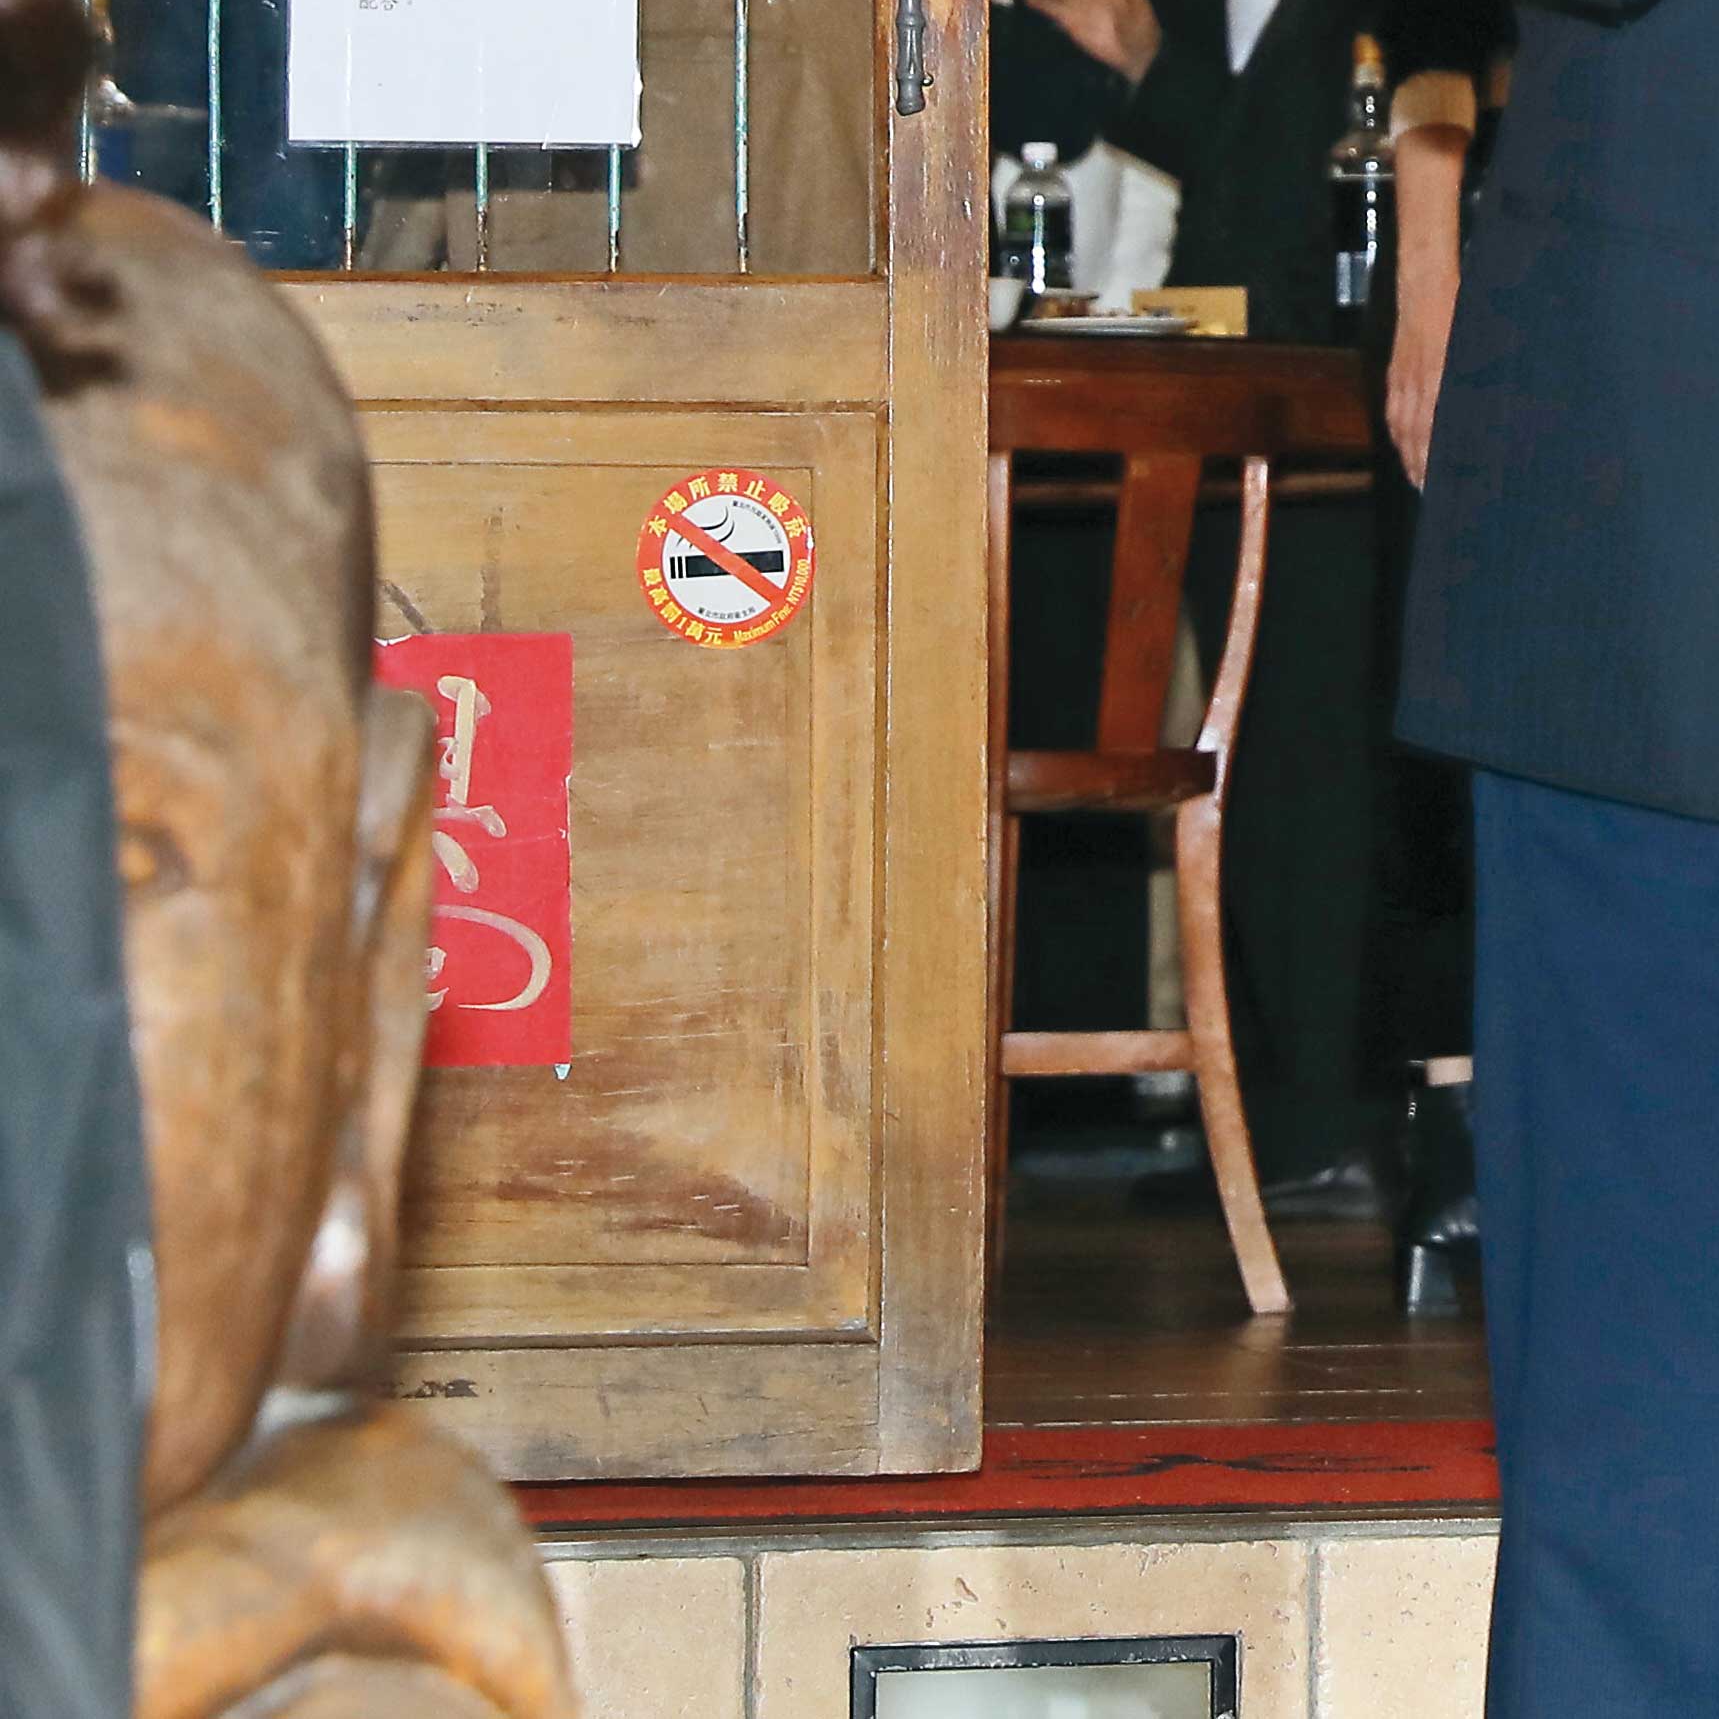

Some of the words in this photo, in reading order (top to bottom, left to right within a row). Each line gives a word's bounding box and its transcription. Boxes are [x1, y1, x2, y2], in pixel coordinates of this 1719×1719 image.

[647, 472, 807, 539] 本場所禁止吸菸
[642, 568, 724, 645] 最高罰1萬元
[733, 618, 776, 642] Maximum
